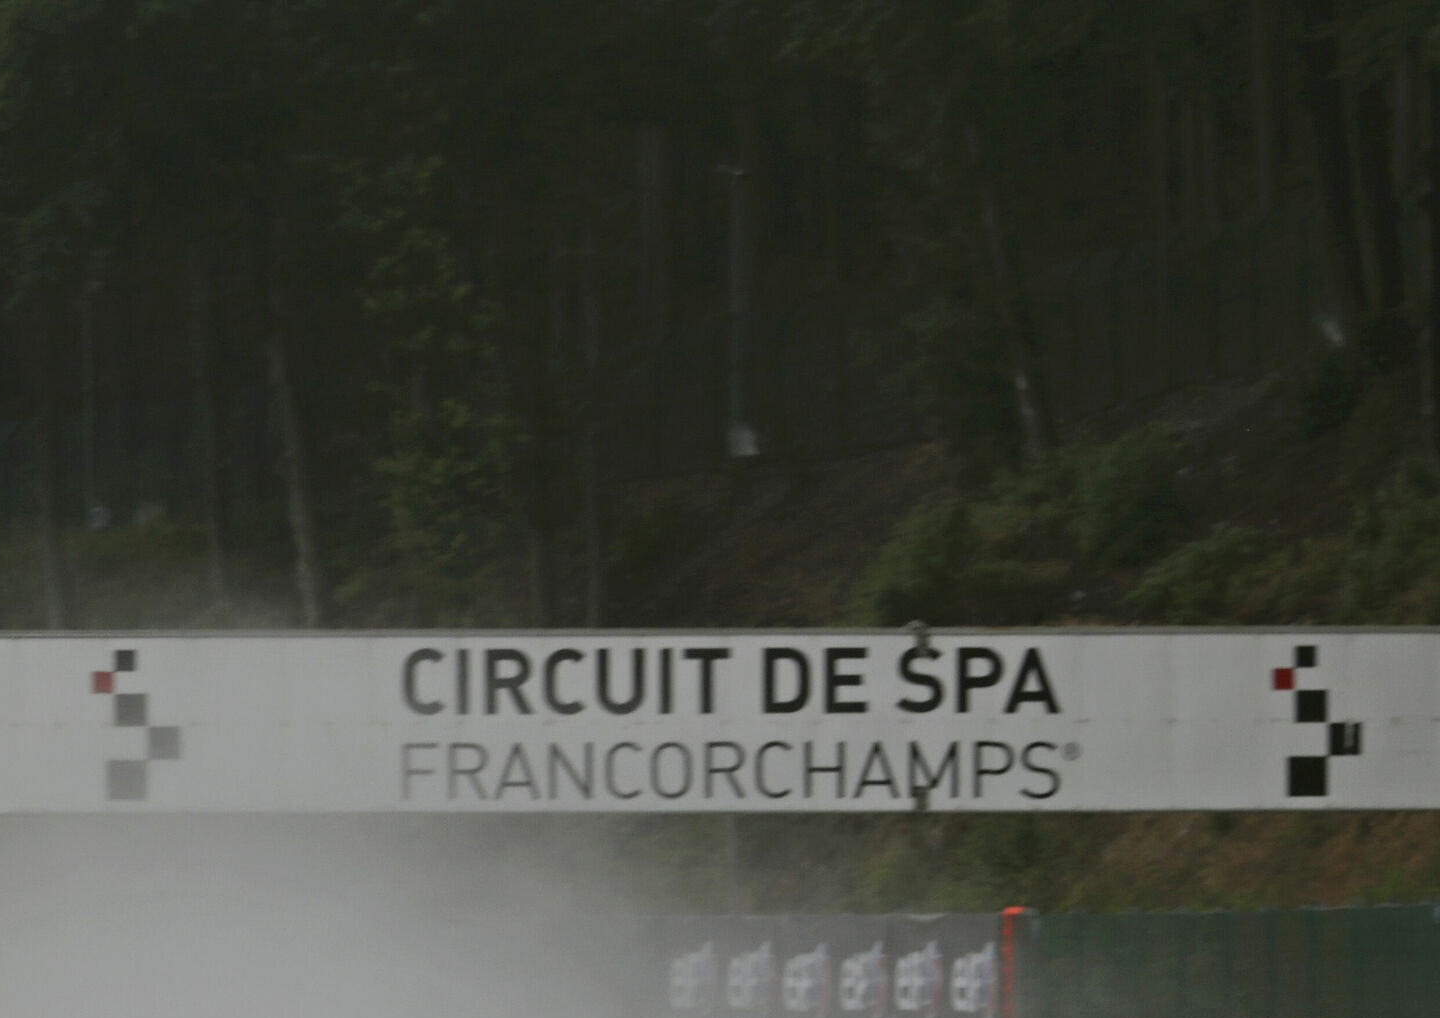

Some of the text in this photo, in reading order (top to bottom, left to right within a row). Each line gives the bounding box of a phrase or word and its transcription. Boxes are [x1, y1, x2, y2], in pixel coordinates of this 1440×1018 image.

[402, 646, 1062, 715] CIRCUIT DE SPA
[402, 740, 1062, 800] FRANCORCHAMPS
